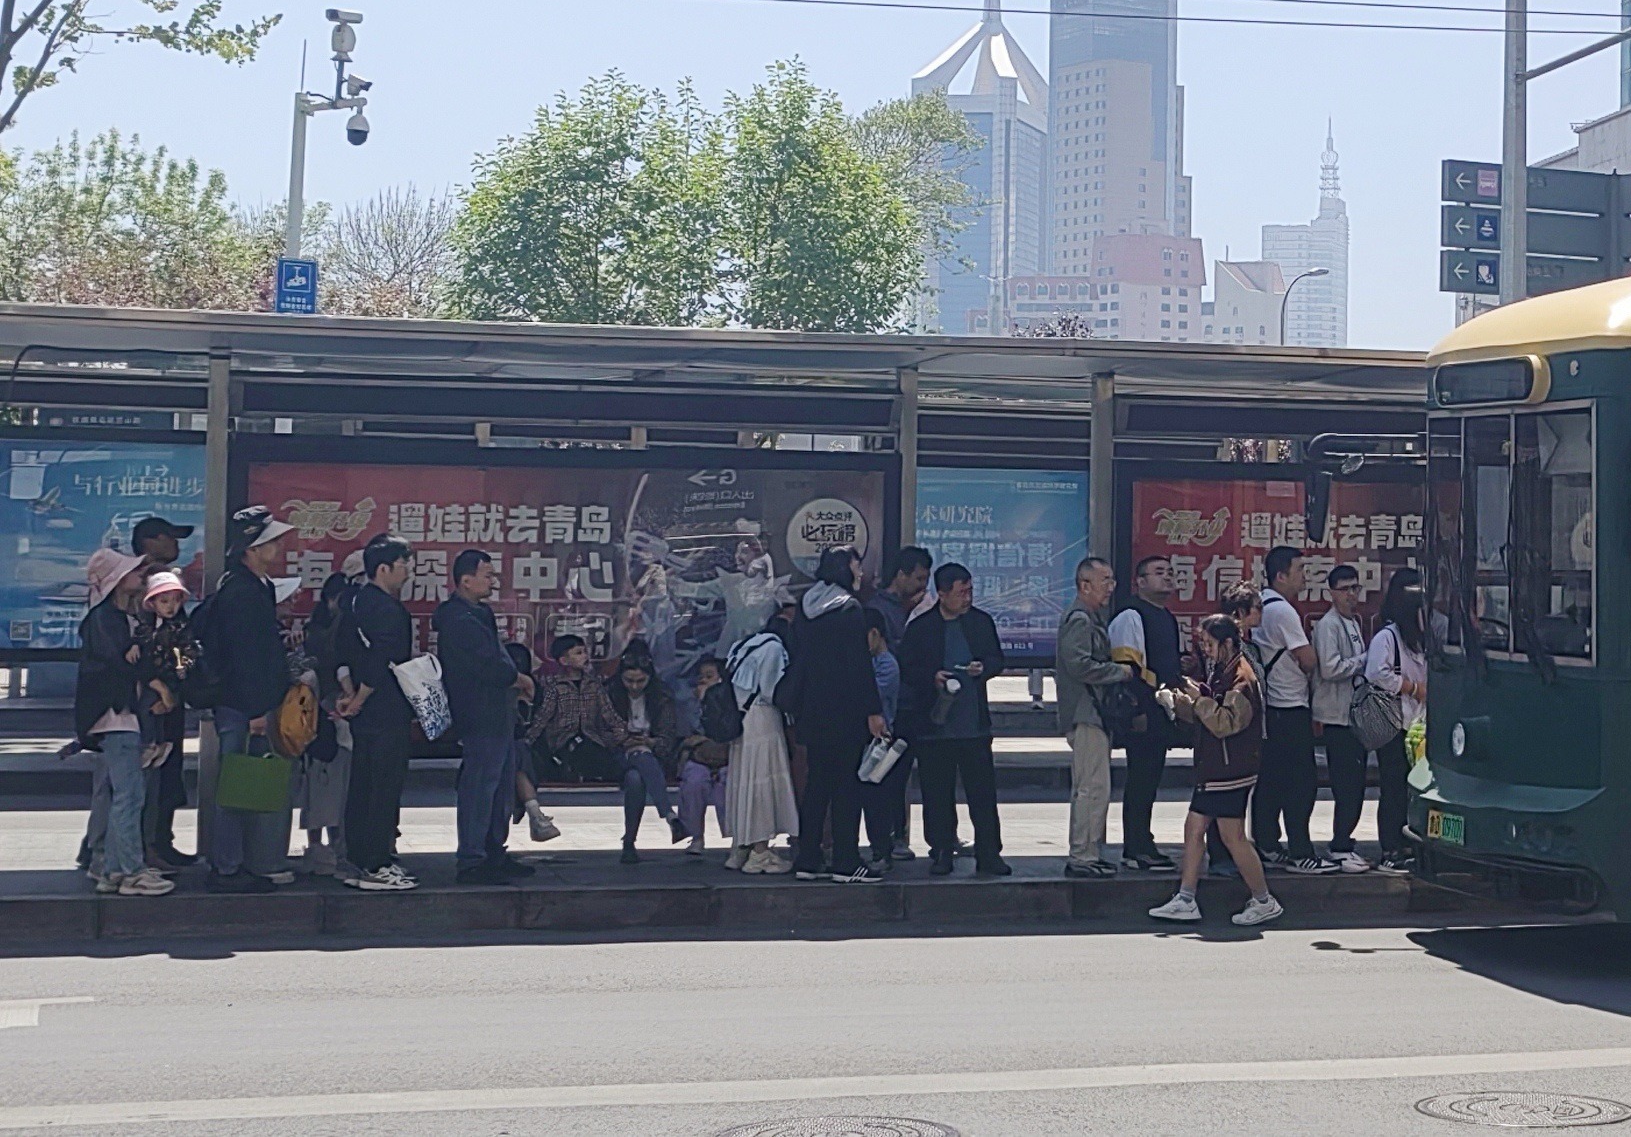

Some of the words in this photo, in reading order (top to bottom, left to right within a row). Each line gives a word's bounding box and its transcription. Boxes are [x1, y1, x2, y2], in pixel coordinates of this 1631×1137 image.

[388, 503, 612, 545] 遛娃就去青岛
[914, 505, 994, 526] 术研究院
[286, 549, 615, 603] 海探中心
